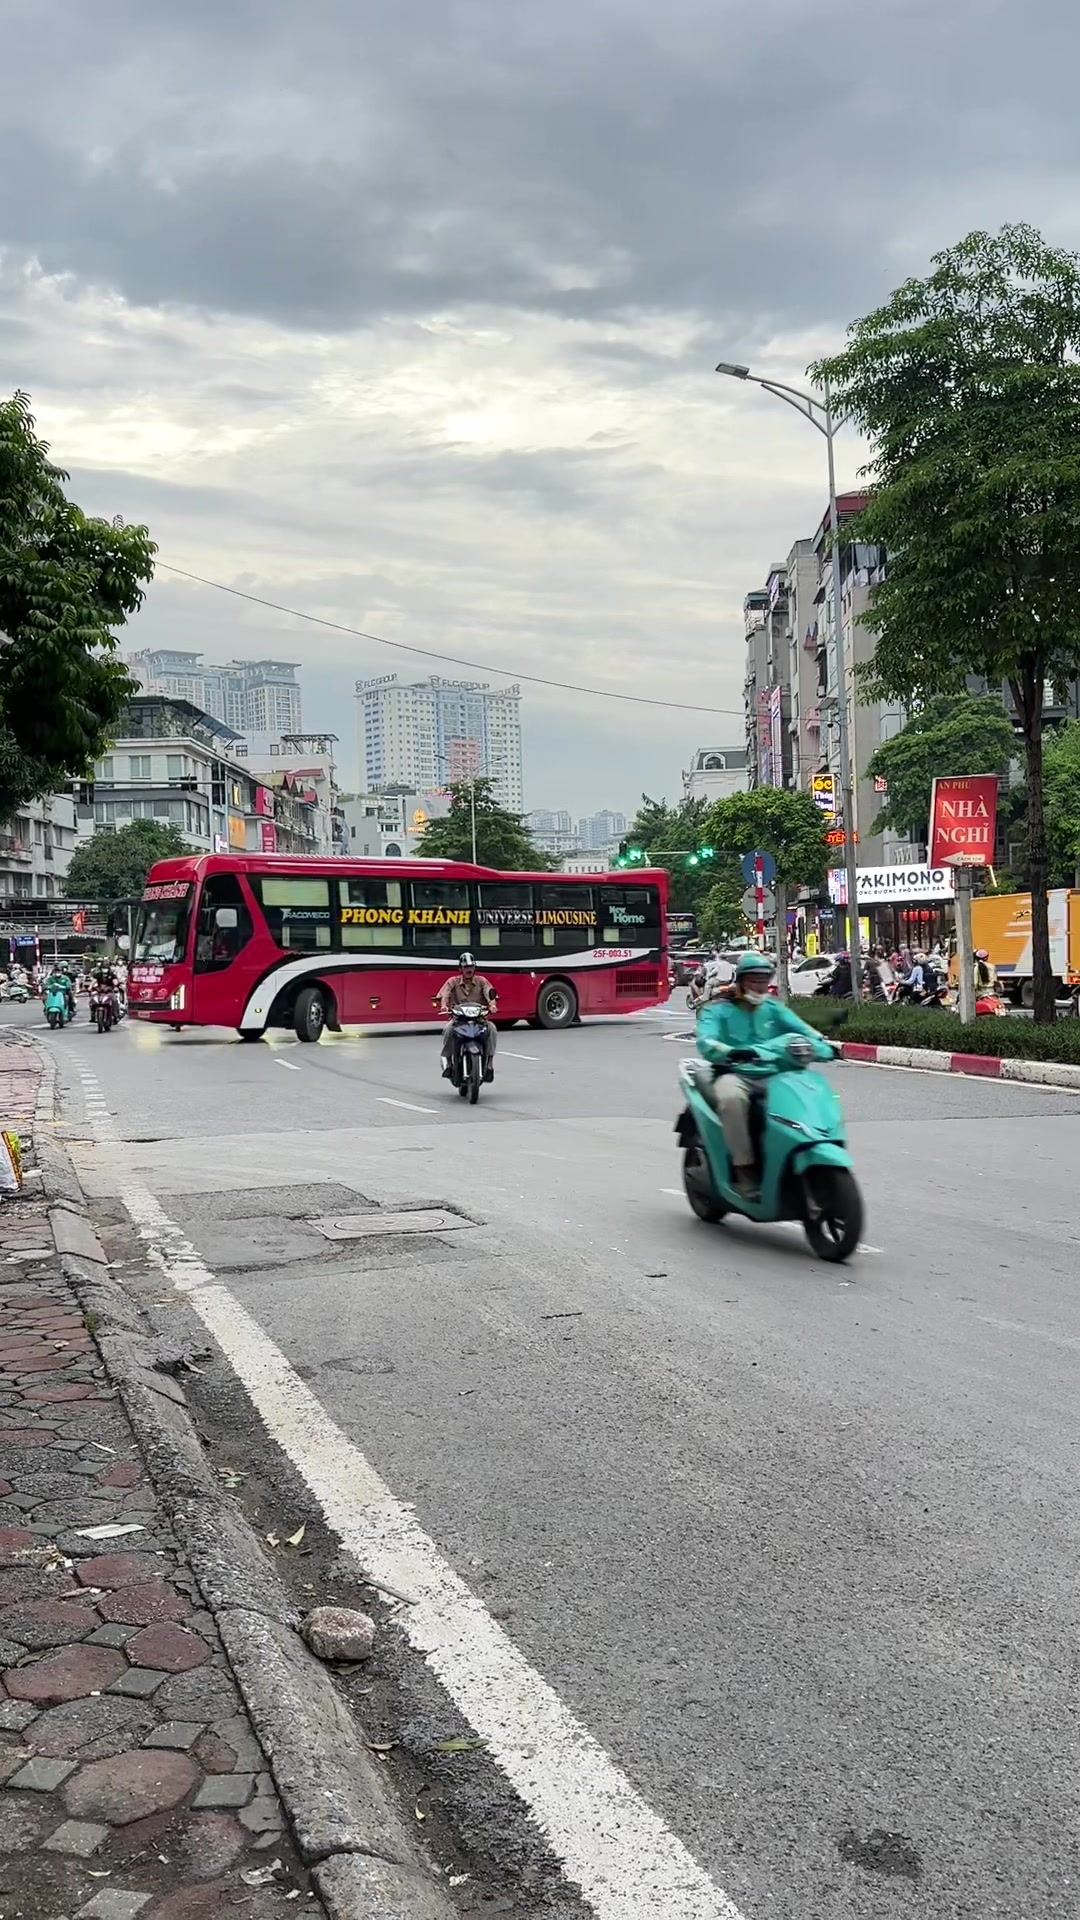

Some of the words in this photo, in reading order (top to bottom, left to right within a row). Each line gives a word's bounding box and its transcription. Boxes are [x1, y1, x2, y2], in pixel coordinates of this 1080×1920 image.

[941, 795, 989, 818] NHÀ
[936, 822, 989, 844] NGHỈ
[340, 908, 403, 923] PHONG
[408, 905, 471, 924] KHÁNH
[477, 909, 534, 924] UNIVERSE
[535, 910, 597, 925] LIMOUSINE
[613, 912, 646, 924] Home
[593, 949, 632, 958] 25F-003.51
